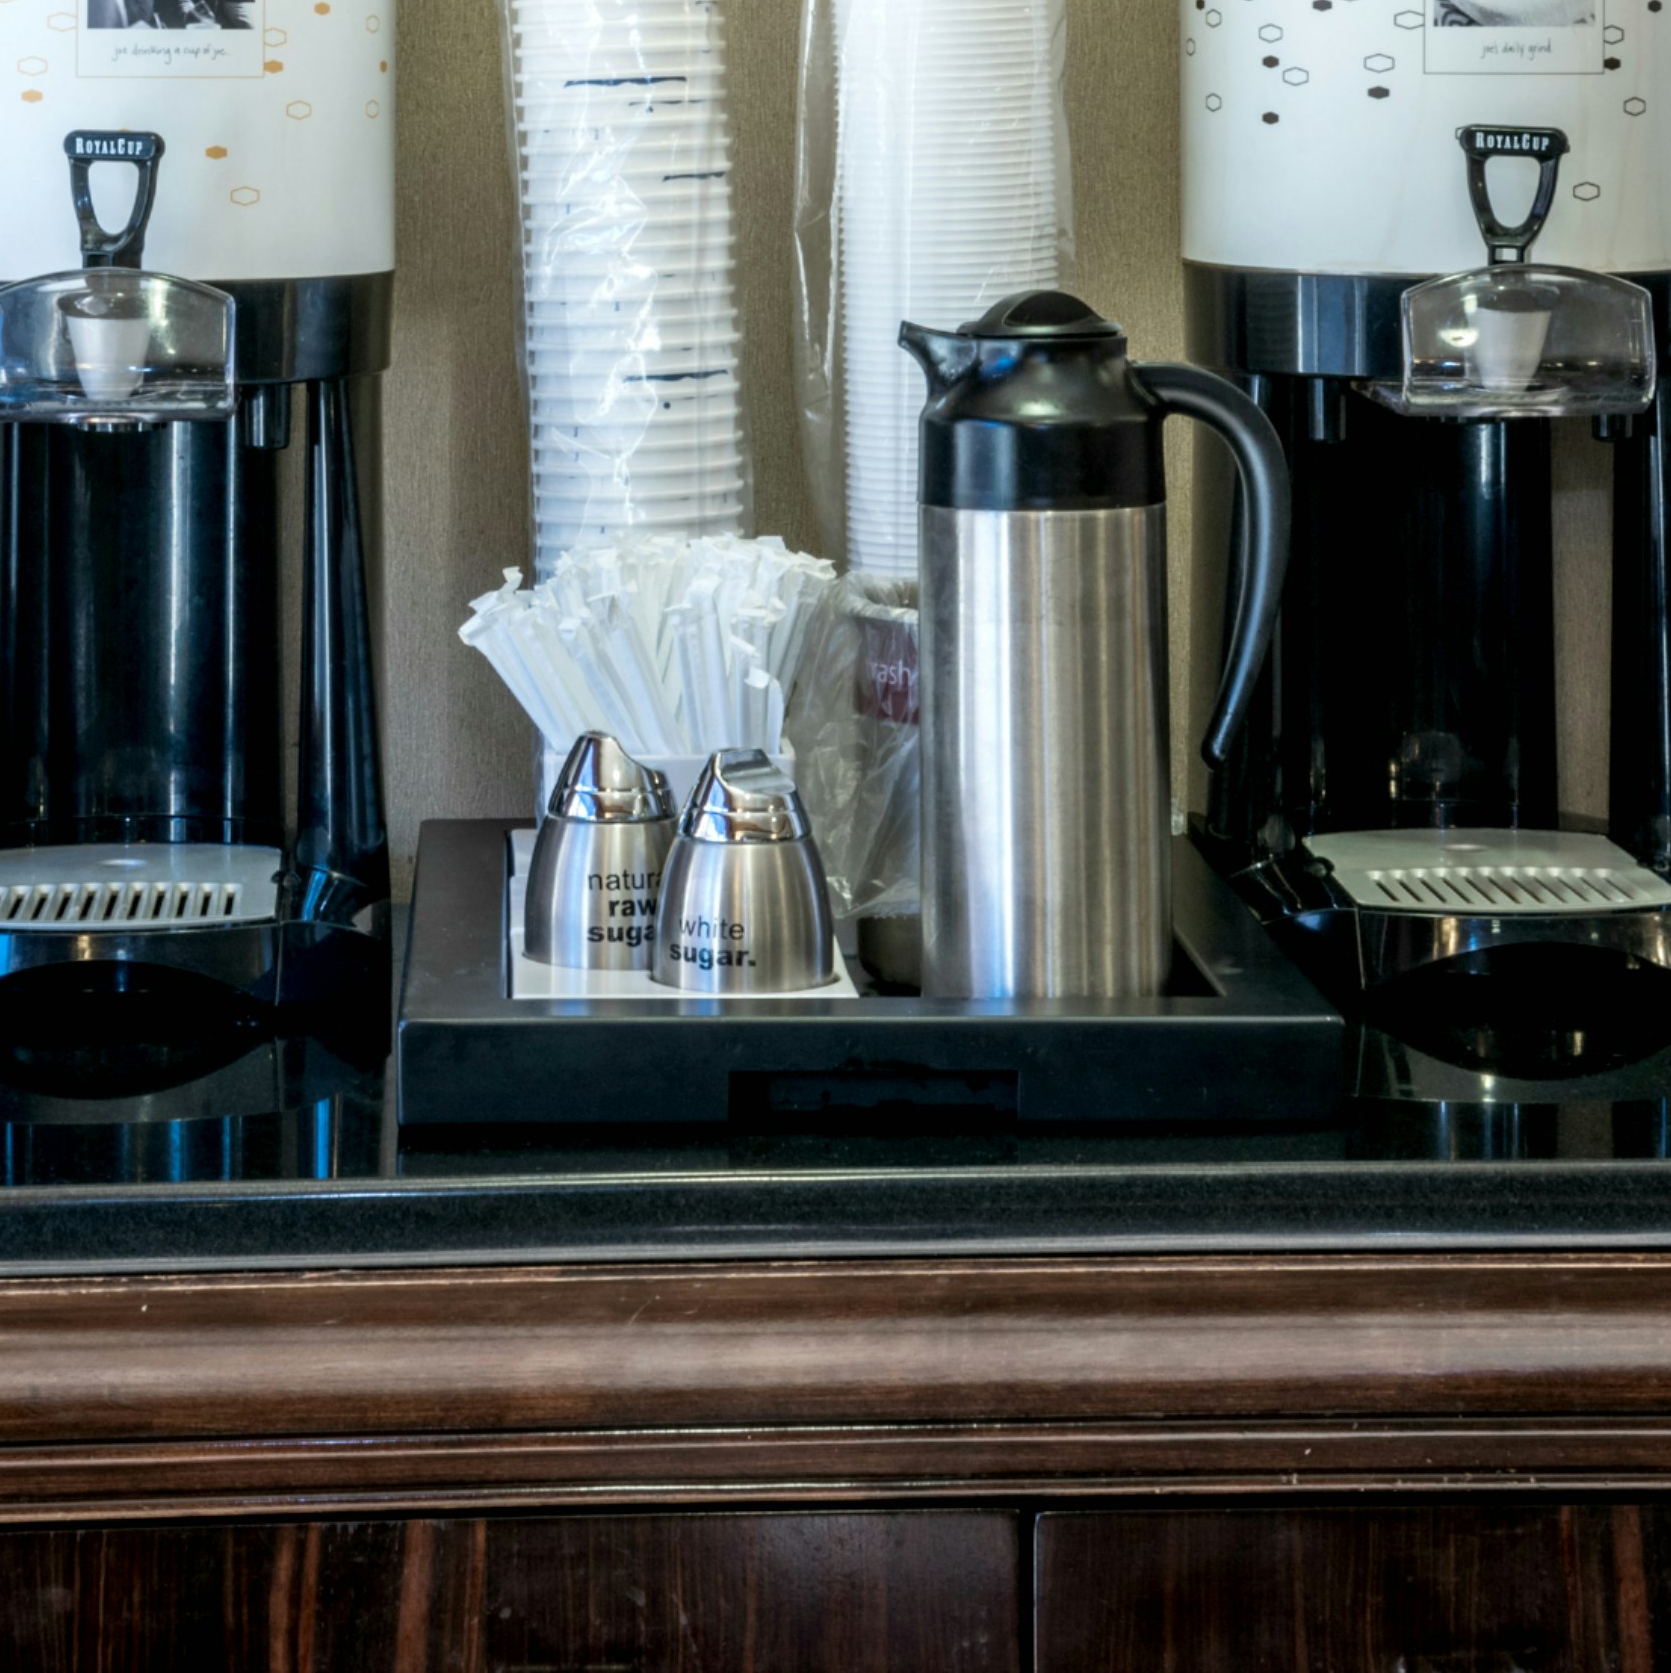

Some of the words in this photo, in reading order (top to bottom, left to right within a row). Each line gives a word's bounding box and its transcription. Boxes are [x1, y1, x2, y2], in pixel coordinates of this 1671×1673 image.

[131, 43, 171, 65] drinking
[183, 47, 200, 59] cup
[1501, 42, 1525, 58] daily
[1528, 37, 1552, 61] grind
[869, 658, 911, 690] rash
[609, 898, 658, 917] raw
[587, 924, 656, 947] suga
[679, 915, 745, 940] white
[669, 943, 756, 970] sugar.
